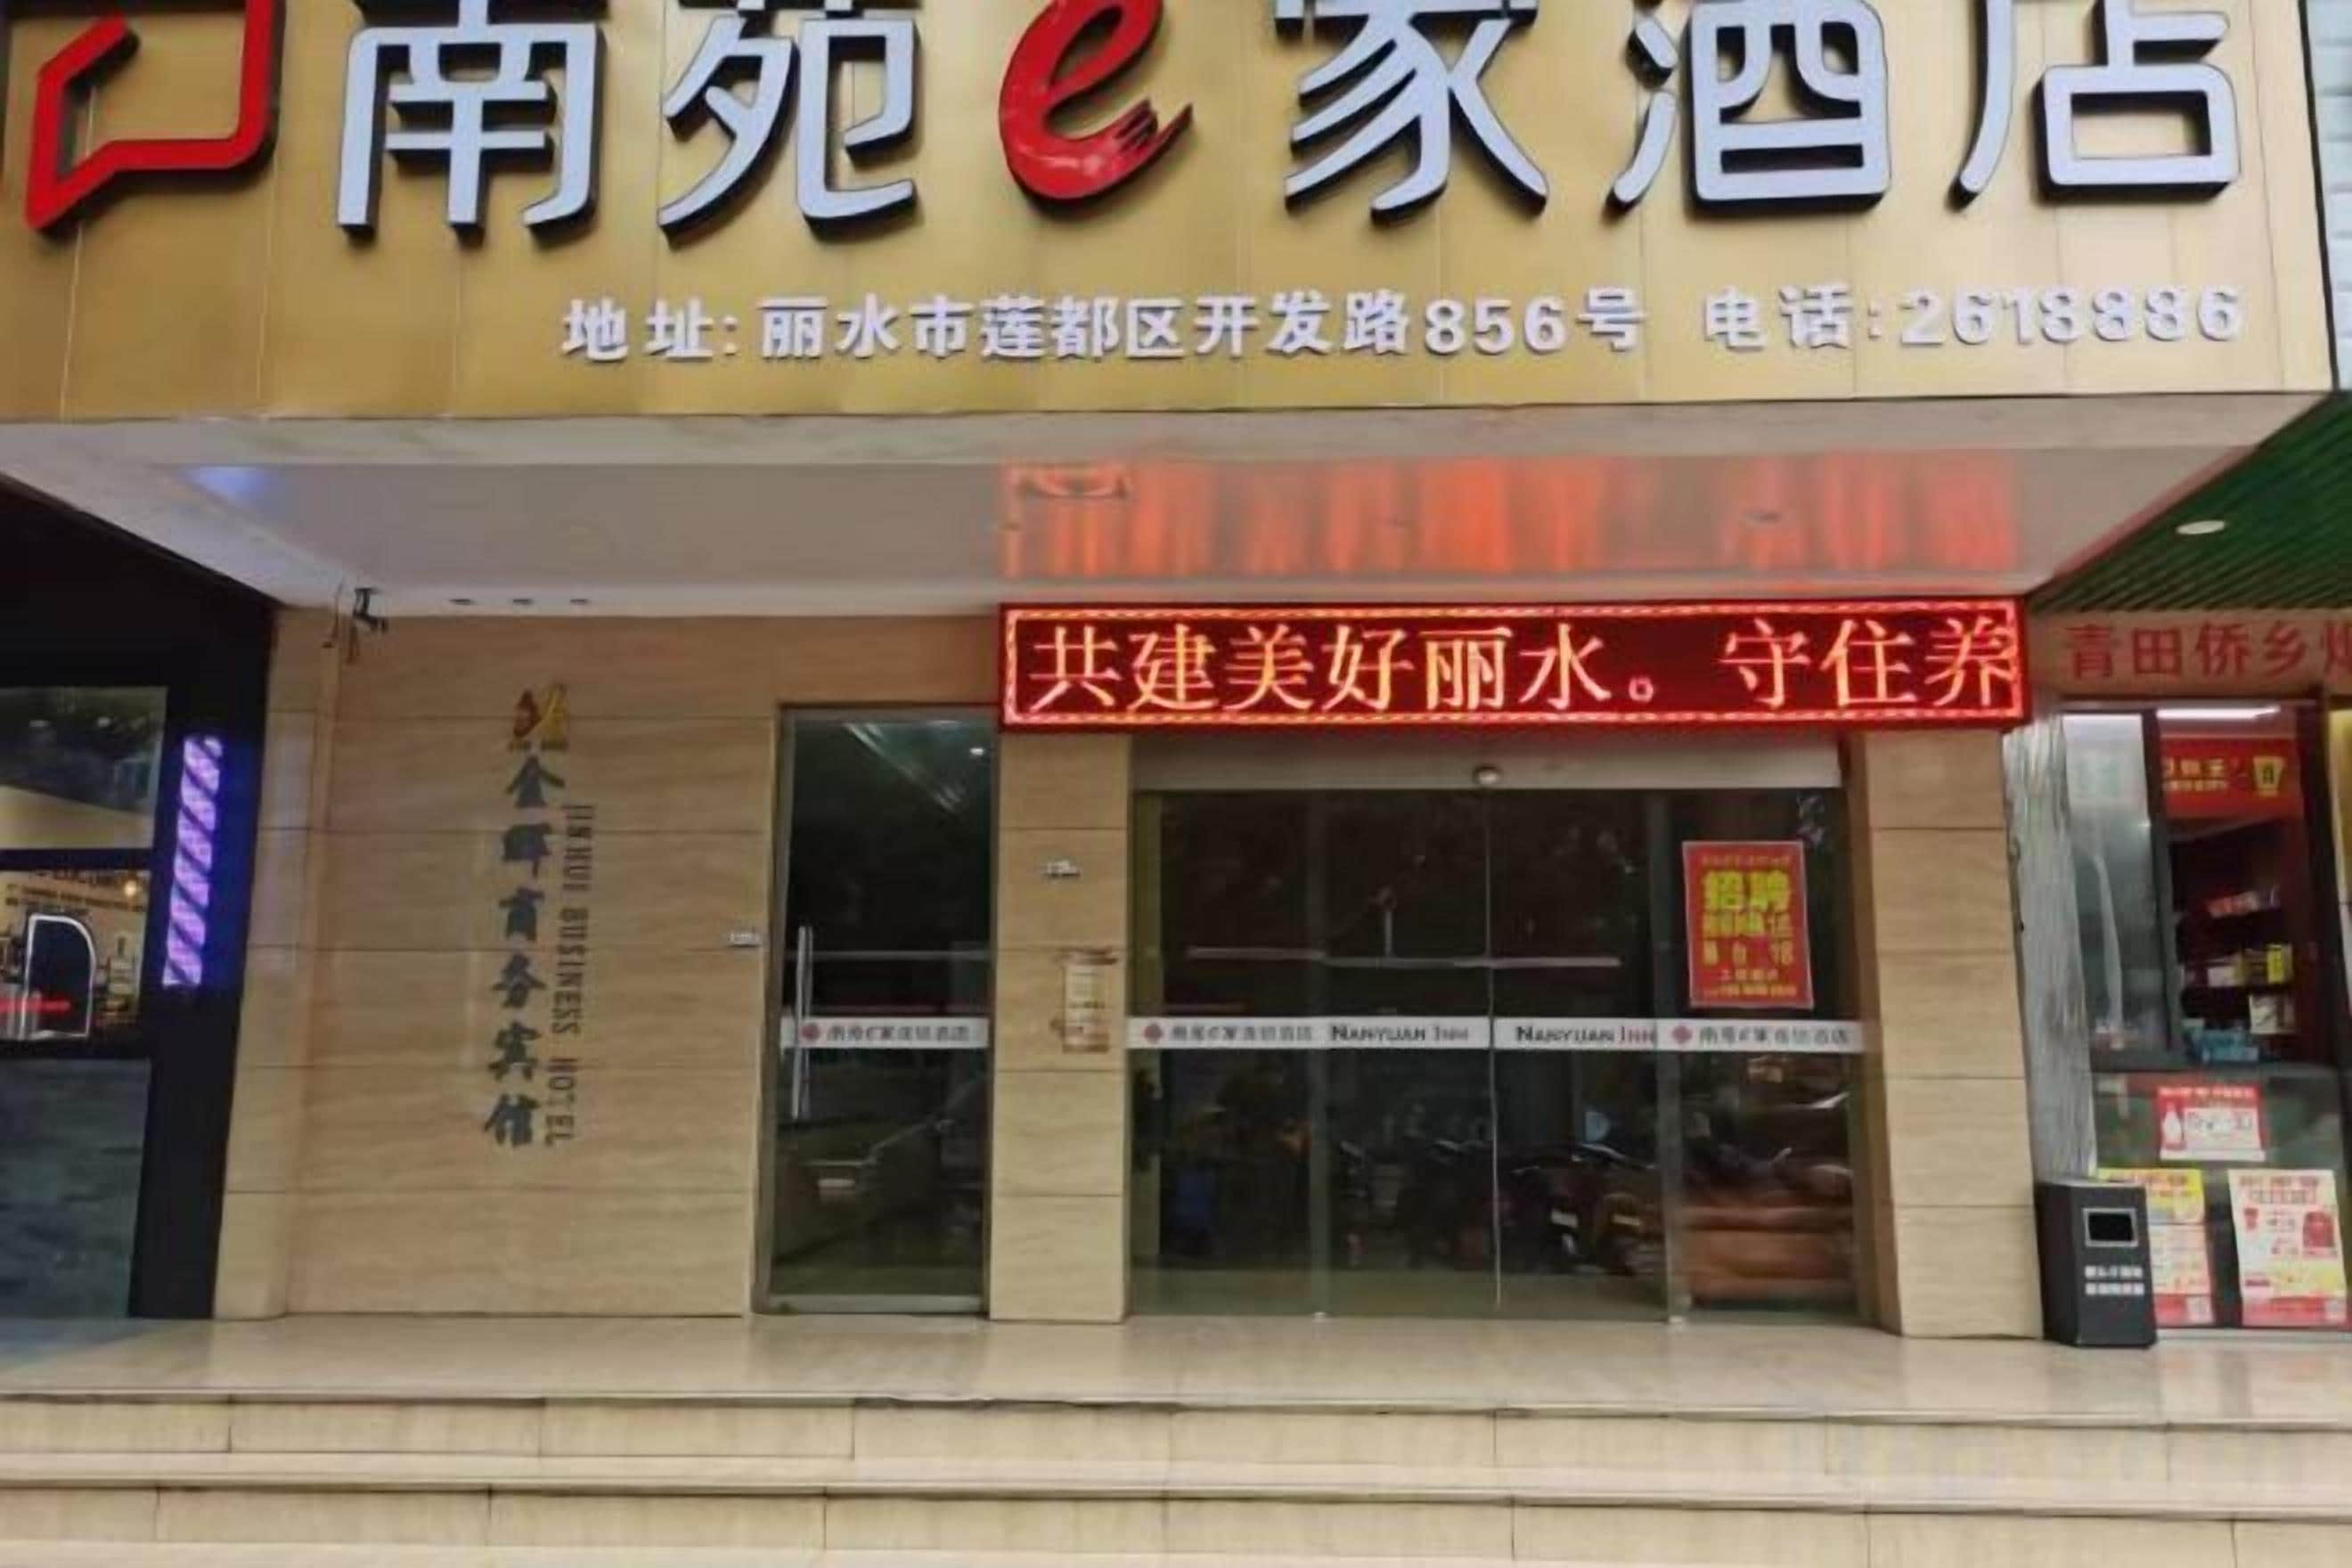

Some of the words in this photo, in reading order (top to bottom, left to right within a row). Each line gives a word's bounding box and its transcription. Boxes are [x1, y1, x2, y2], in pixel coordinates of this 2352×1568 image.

[337, 0, 2242, 235] 南苑e家酒店
